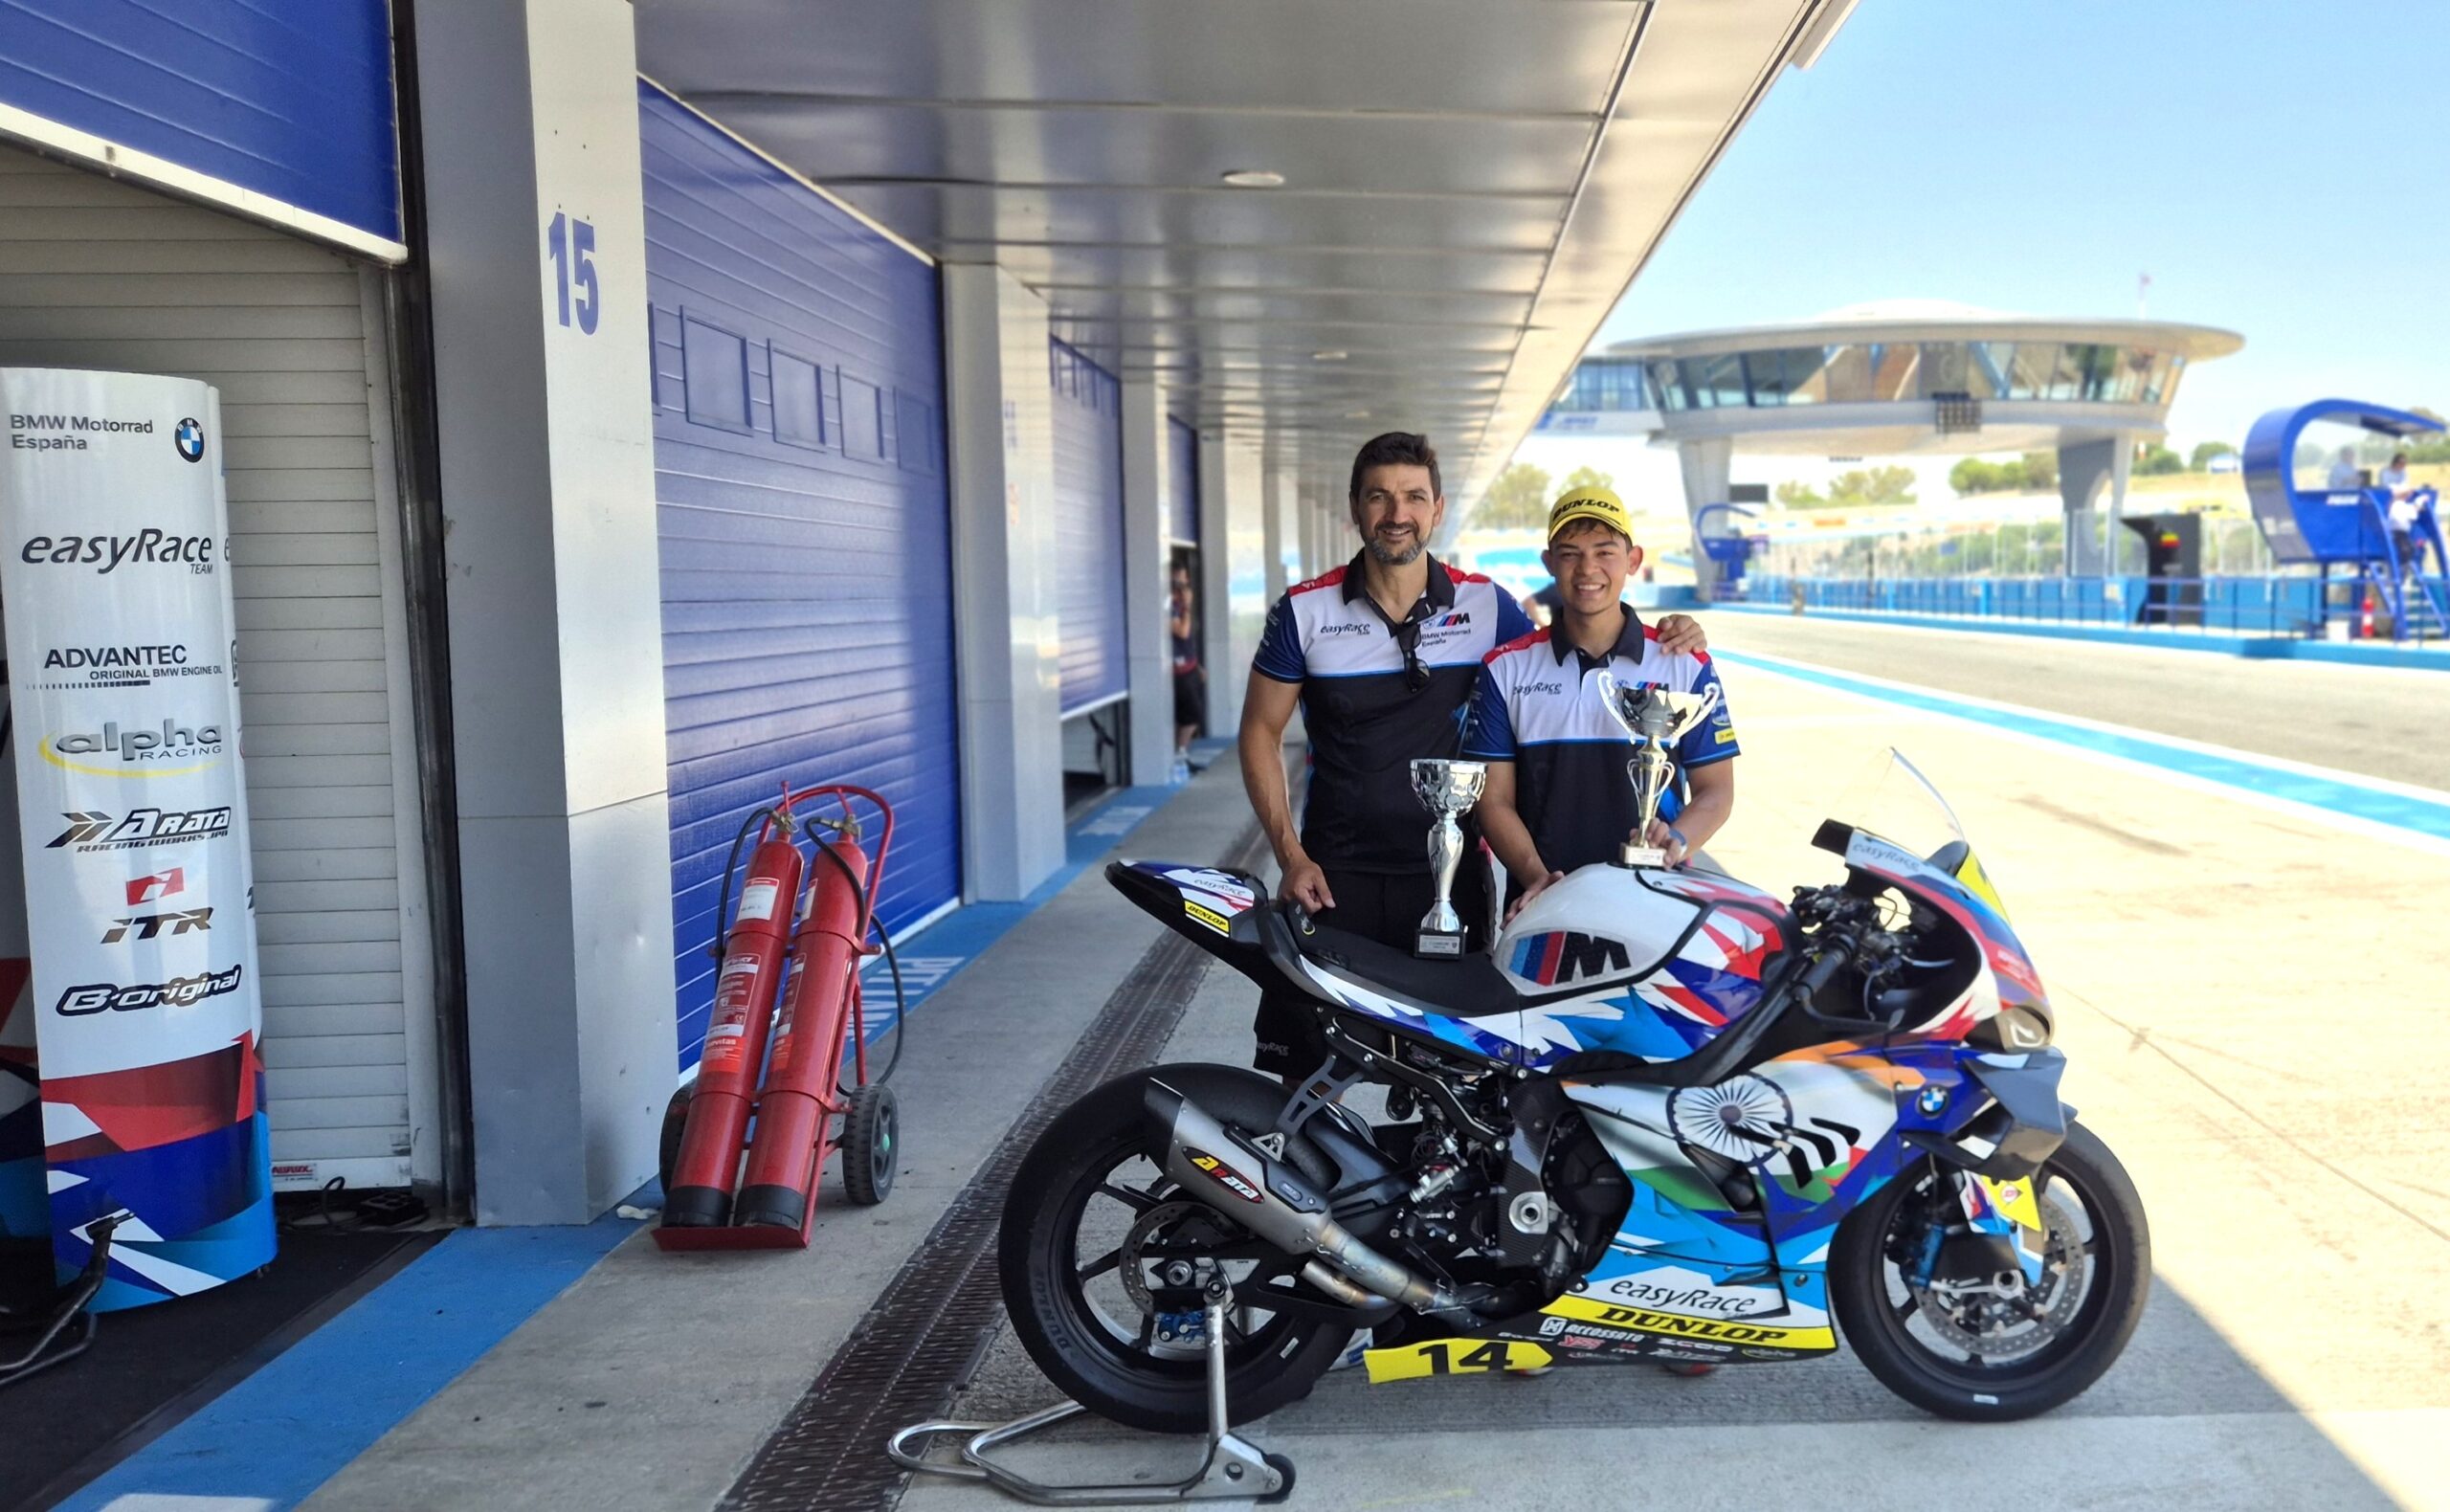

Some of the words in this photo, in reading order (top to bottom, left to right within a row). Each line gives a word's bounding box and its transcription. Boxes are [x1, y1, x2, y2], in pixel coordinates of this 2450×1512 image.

[548, 211, 599, 335] 15
[11, 414, 66, 431] BMW
[71, 416, 153, 434] Motorrad
[12, 435, 87, 451] España
[1553, 499, 1619, 522] DUNLOP
[21, 528, 212, 574] easyRace
[190, 564, 213, 575] TEAM
[1321, 623, 1370, 635] easyRace
[44, 645, 187, 669] ADVANTEC
[90, 668, 149, 680] ORIGINAL
[153, 666, 179, 678] BMW
[182, 665, 212, 676] ENGINE
[213, 665, 223, 675] OIL
[1512, 682, 1562, 696] easyRace
[56, 719, 221, 761] alpha
[141, 745, 222, 760] RACING
[102, 807, 231, 842] ARATA
[1854, 841, 1920, 872] easyRace
[1194, 878, 1247, 896] easyRace
[1188, 904, 1227, 927] DUNLOP
[1610, 1279, 1757, 1313] easyRace
[1565, 1323, 1646, 1343] ACCOSSATO
[1596, 1307, 1789, 1342] DUNLOP
[1418, 1342, 1513, 1374] 14
